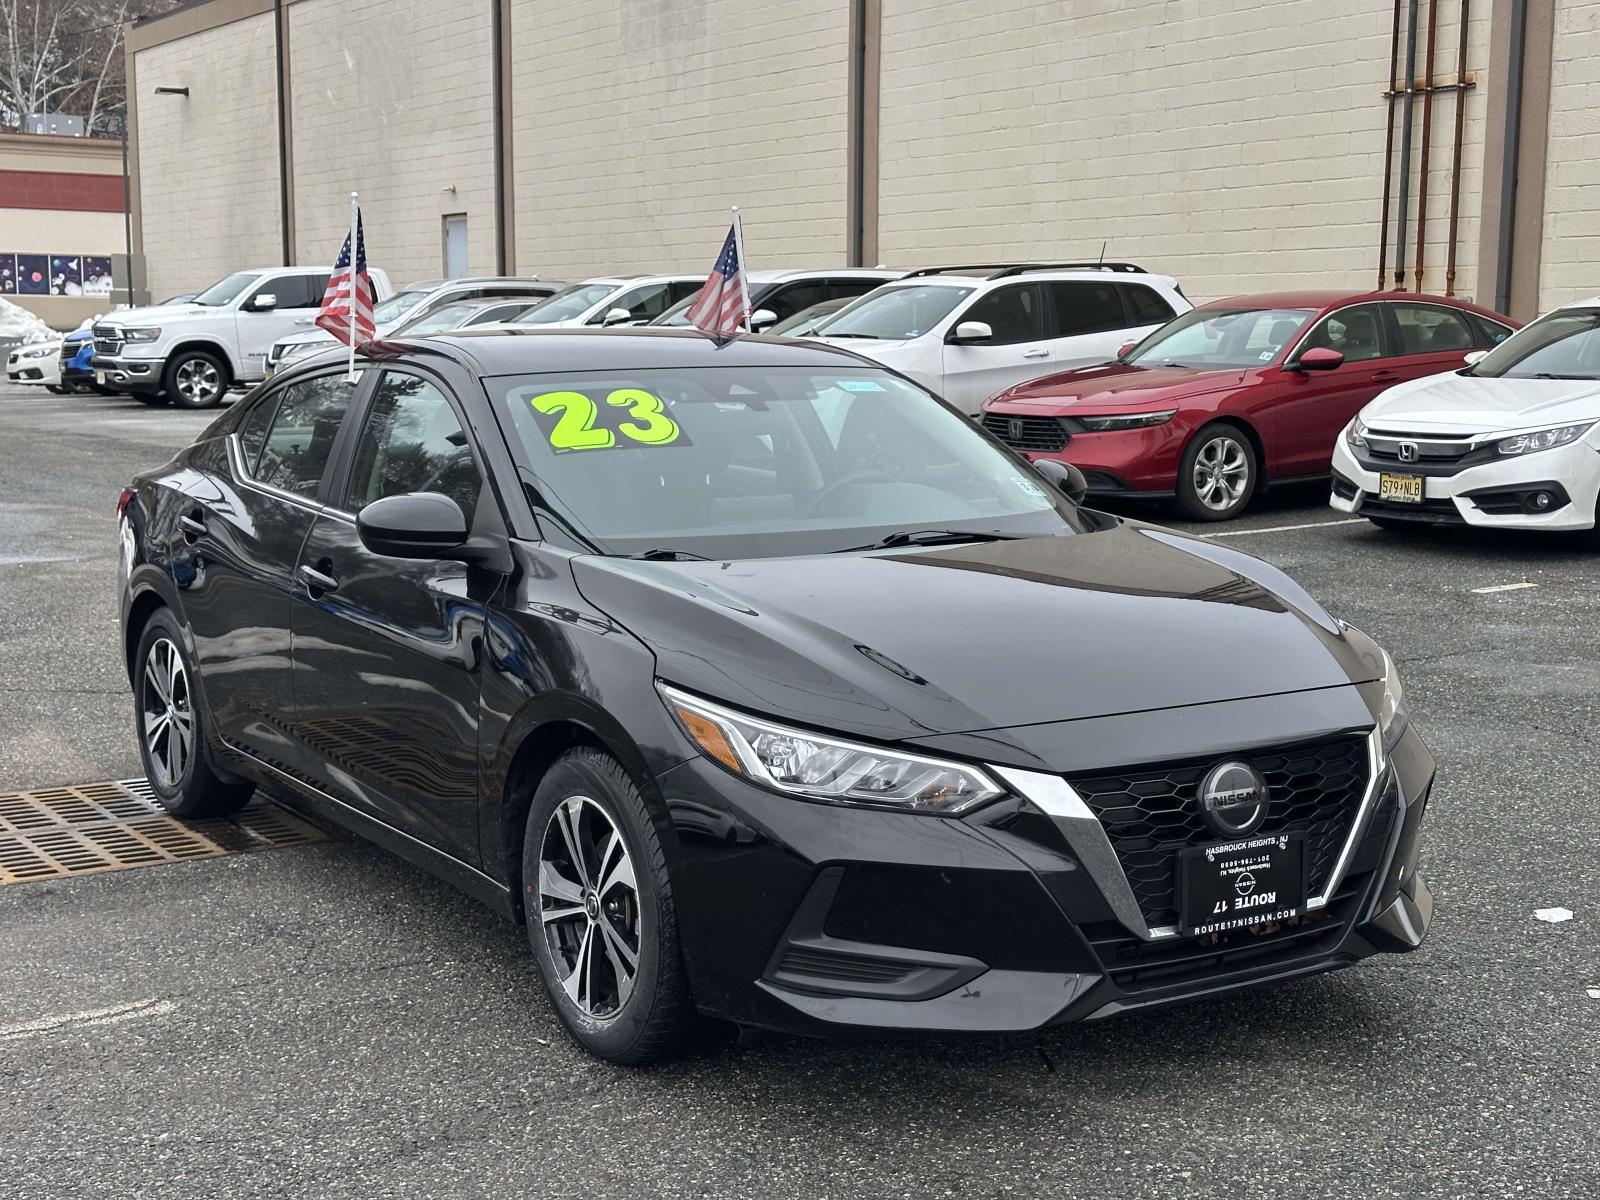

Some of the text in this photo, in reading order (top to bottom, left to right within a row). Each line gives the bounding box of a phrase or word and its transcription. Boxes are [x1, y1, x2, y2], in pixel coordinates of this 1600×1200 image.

[530, 388, 680, 451] 23
[1213, 790, 1261, 807] NISSAN
[1206, 841, 1247, 855] HASBROUCK
[1279, 834, 1289, 843] NJ
[1234, 879, 1257, 888] NISSAN
[1213, 891, 1277, 914] ROUTE 17
[1194, 908, 1297, 936] ROUTE17NISSAN.COM
